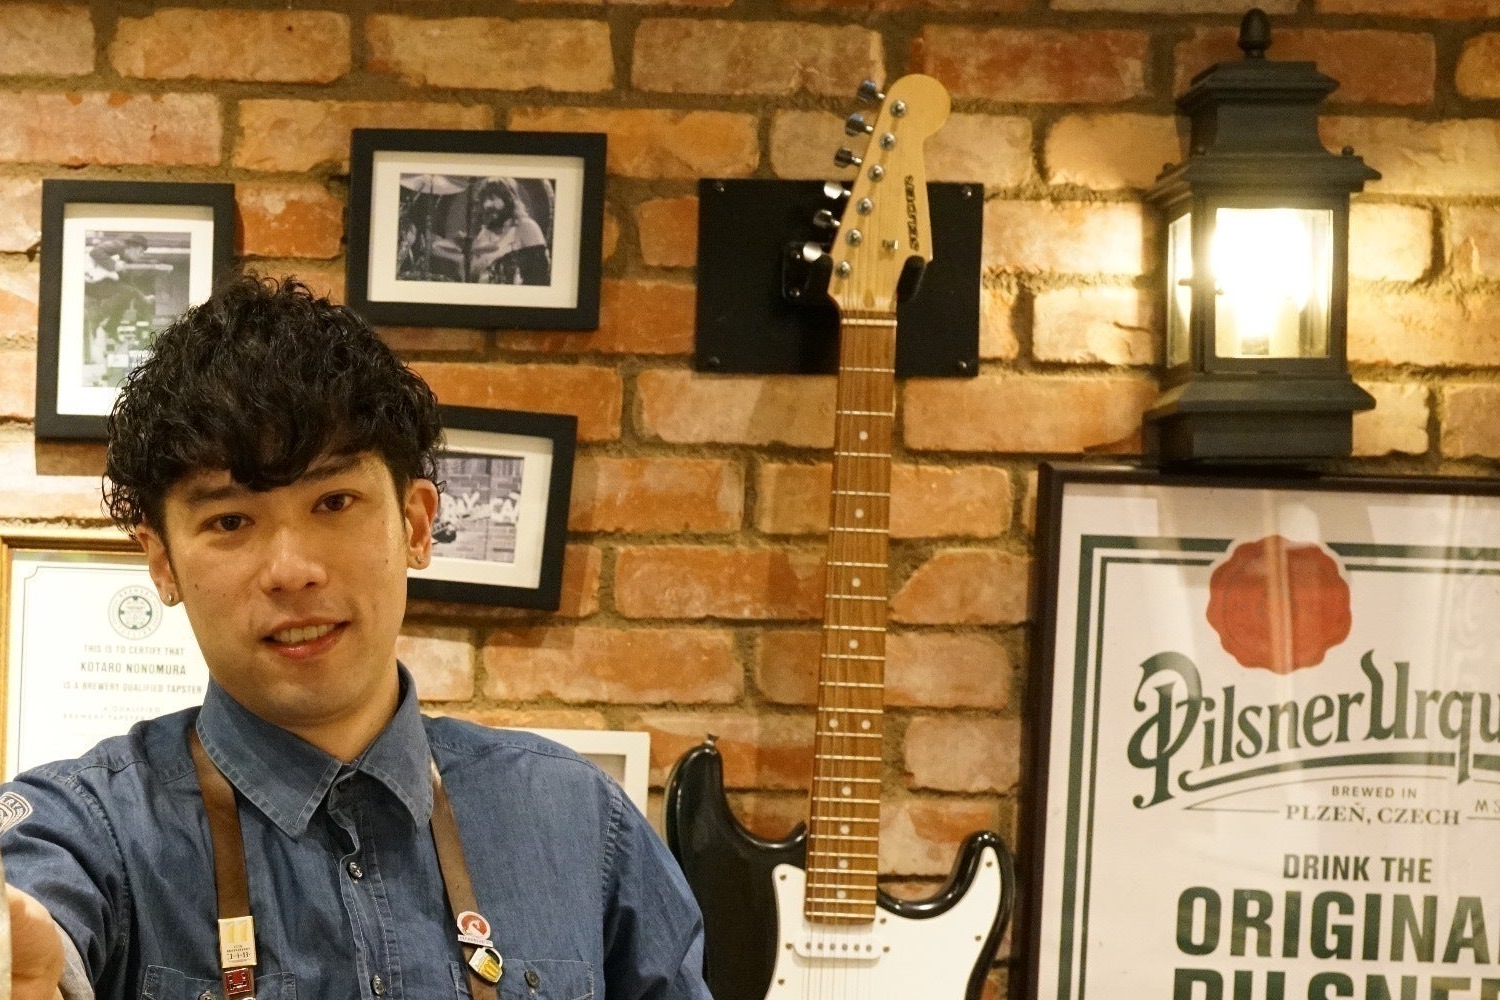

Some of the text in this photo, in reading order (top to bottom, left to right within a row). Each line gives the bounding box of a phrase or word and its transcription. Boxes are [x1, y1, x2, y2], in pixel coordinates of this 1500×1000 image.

[80, 661, 187, 676] KOTARO NONOMURA
[167, 684, 203, 695] TAPSTER
[1126, 650, 1365, 810] Pilsner
[1332, 785, 1418, 799] BREWED IN
[1286, 802, 1461, 827] PLZEŇ, CZECH
[1283, 853, 1433, 884] DRINK THE
[1175, 886, 1500, 965] ORIGINA
